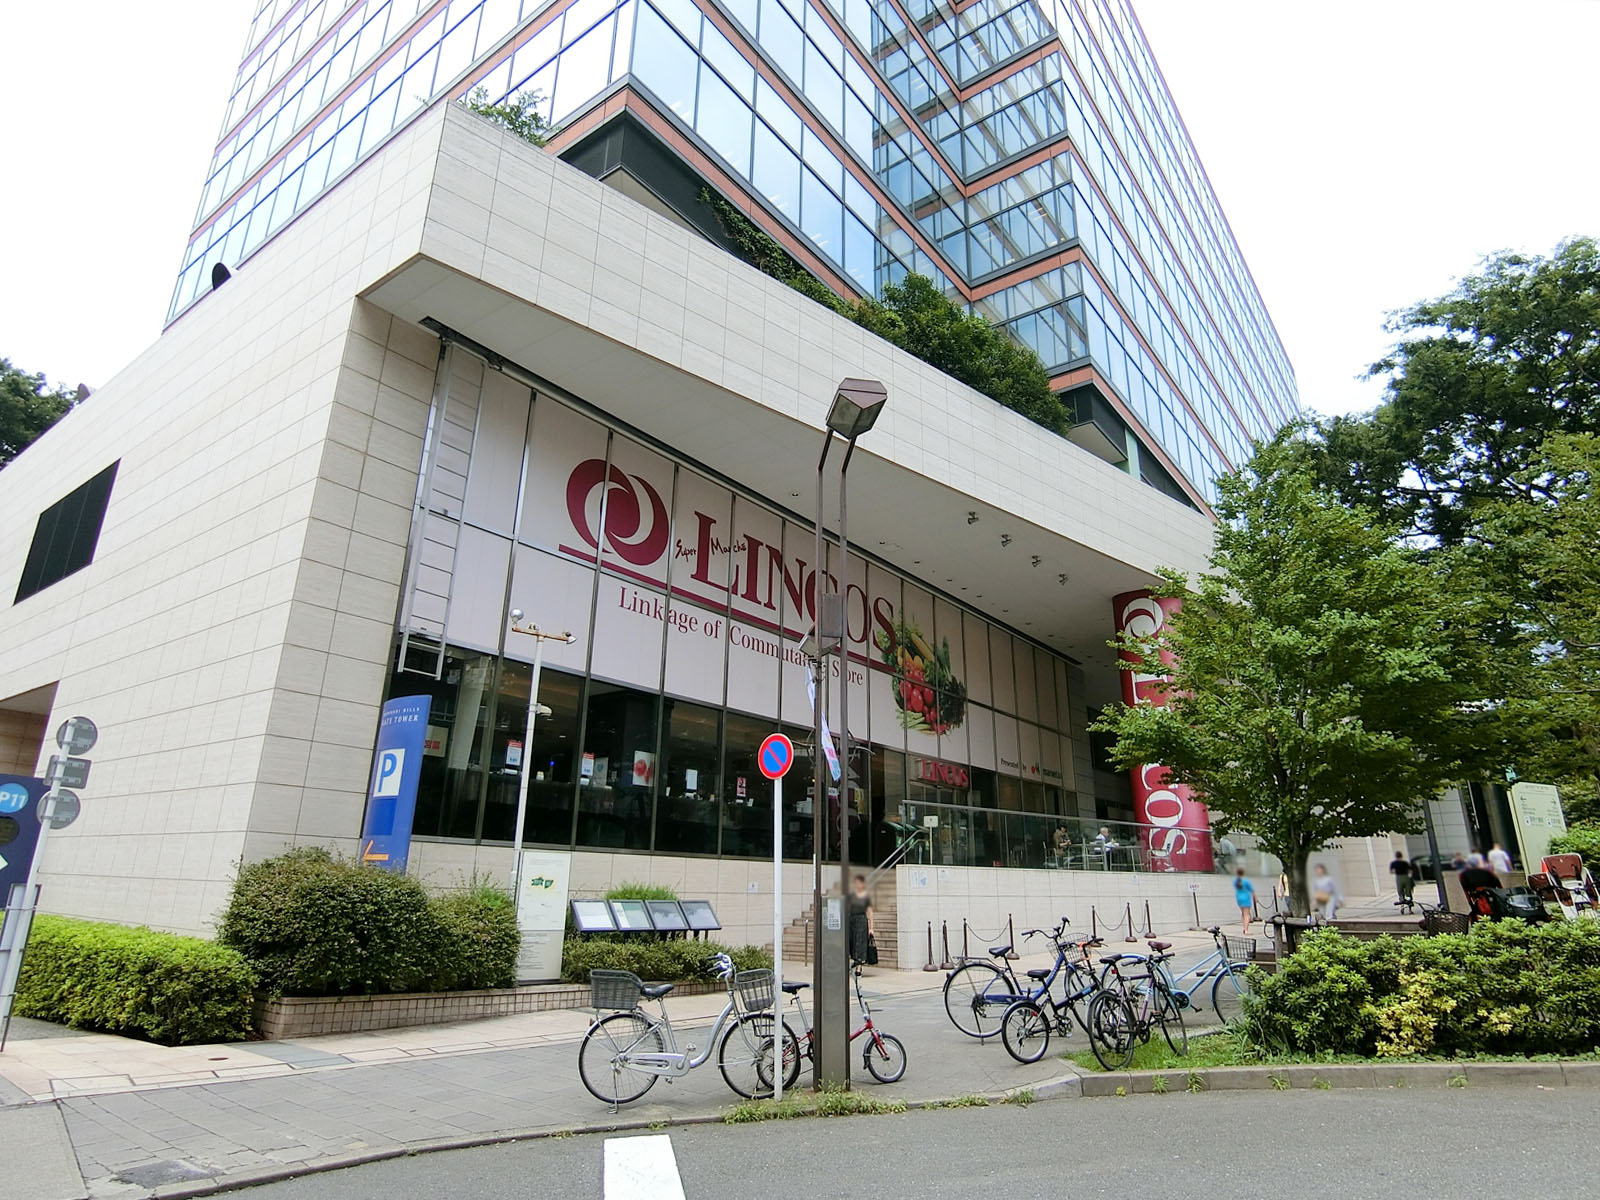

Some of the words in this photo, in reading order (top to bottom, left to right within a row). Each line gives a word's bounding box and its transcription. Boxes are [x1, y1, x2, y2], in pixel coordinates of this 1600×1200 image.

[619, 586, 698, 634] Linkage
[704, 620, 722, 640] of
[394, 714, 419, 724] TOWER
[378, 752, 397, 793] P
